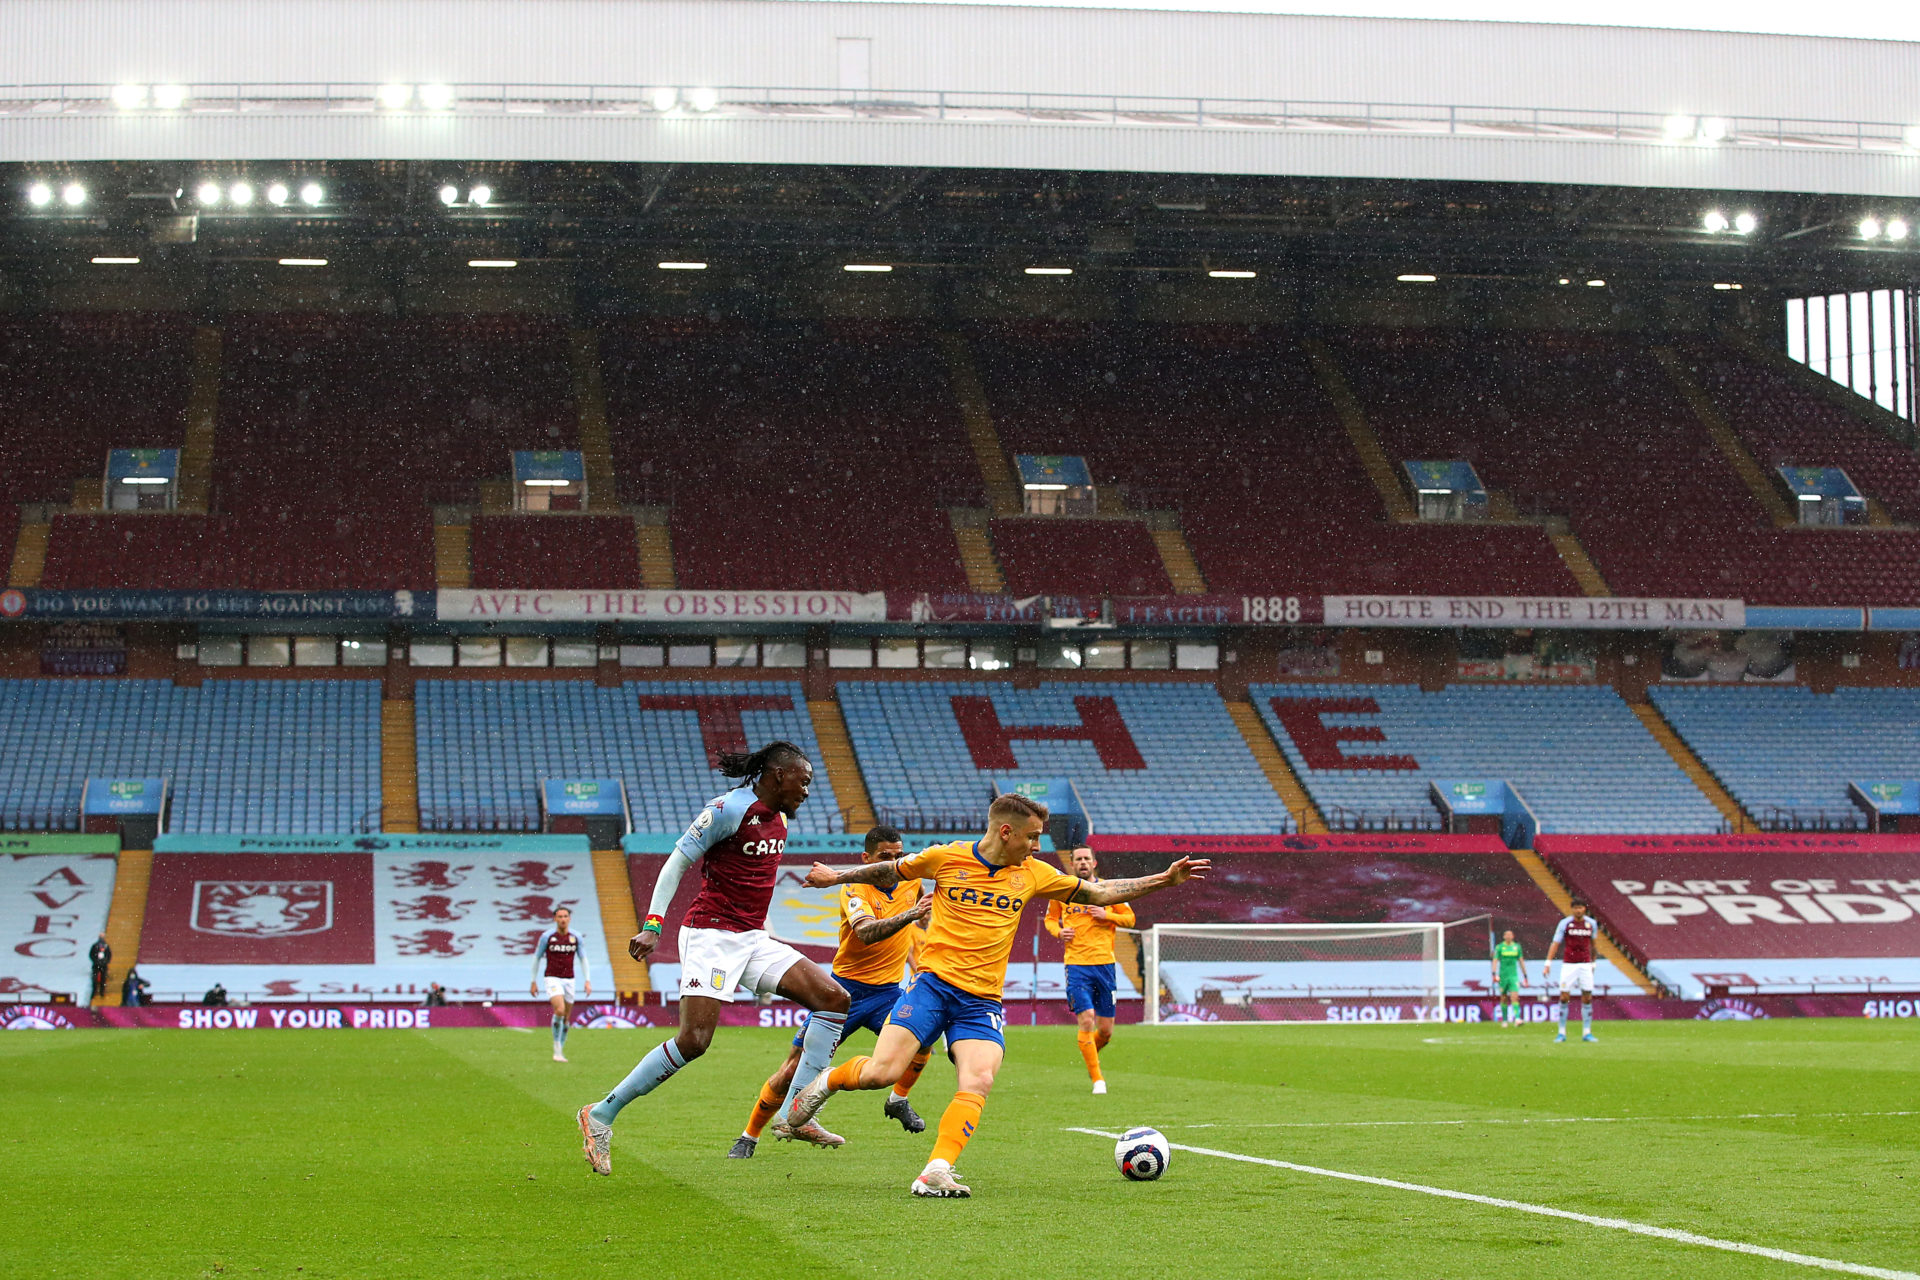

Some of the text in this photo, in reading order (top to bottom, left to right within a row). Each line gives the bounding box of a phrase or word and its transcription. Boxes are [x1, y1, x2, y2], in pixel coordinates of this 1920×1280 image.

[36, 597, 64, 611] DO
[72, 597, 111, 611] YOU
[120, 597, 177, 611] WANT
[185, 597, 209, 611] TO
[259, 598, 346, 612] AGAINST
[470, 594, 855, 617] AVFC THE OBSESSION
[1241, 596, 1300, 623] 1888
[1345, 600, 1726, 622] HOLTE END THE 12TH MAN
[1128, 606, 1230, 622] LEAGUE
[240, 839, 503, 850] Premier League
[743, 839, 786, 856] CAZO
[209, 884, 320, 896] AVFC
[1611, 879, 1920, 894] PART OF TH
[948, 887, 1023, 912] CAZOO
[1628, 894, 1920, 924] PRID
[549, 944, 577, 952] CAZOO
[179, 1010, 430, 1028] SHOW YOUR PRIDE
[759, 1008, 812, 1027] SHO
[1326, 1006, 1401, 1023] SHOW
[1413, 1005, 1481, 1023] YOUR
